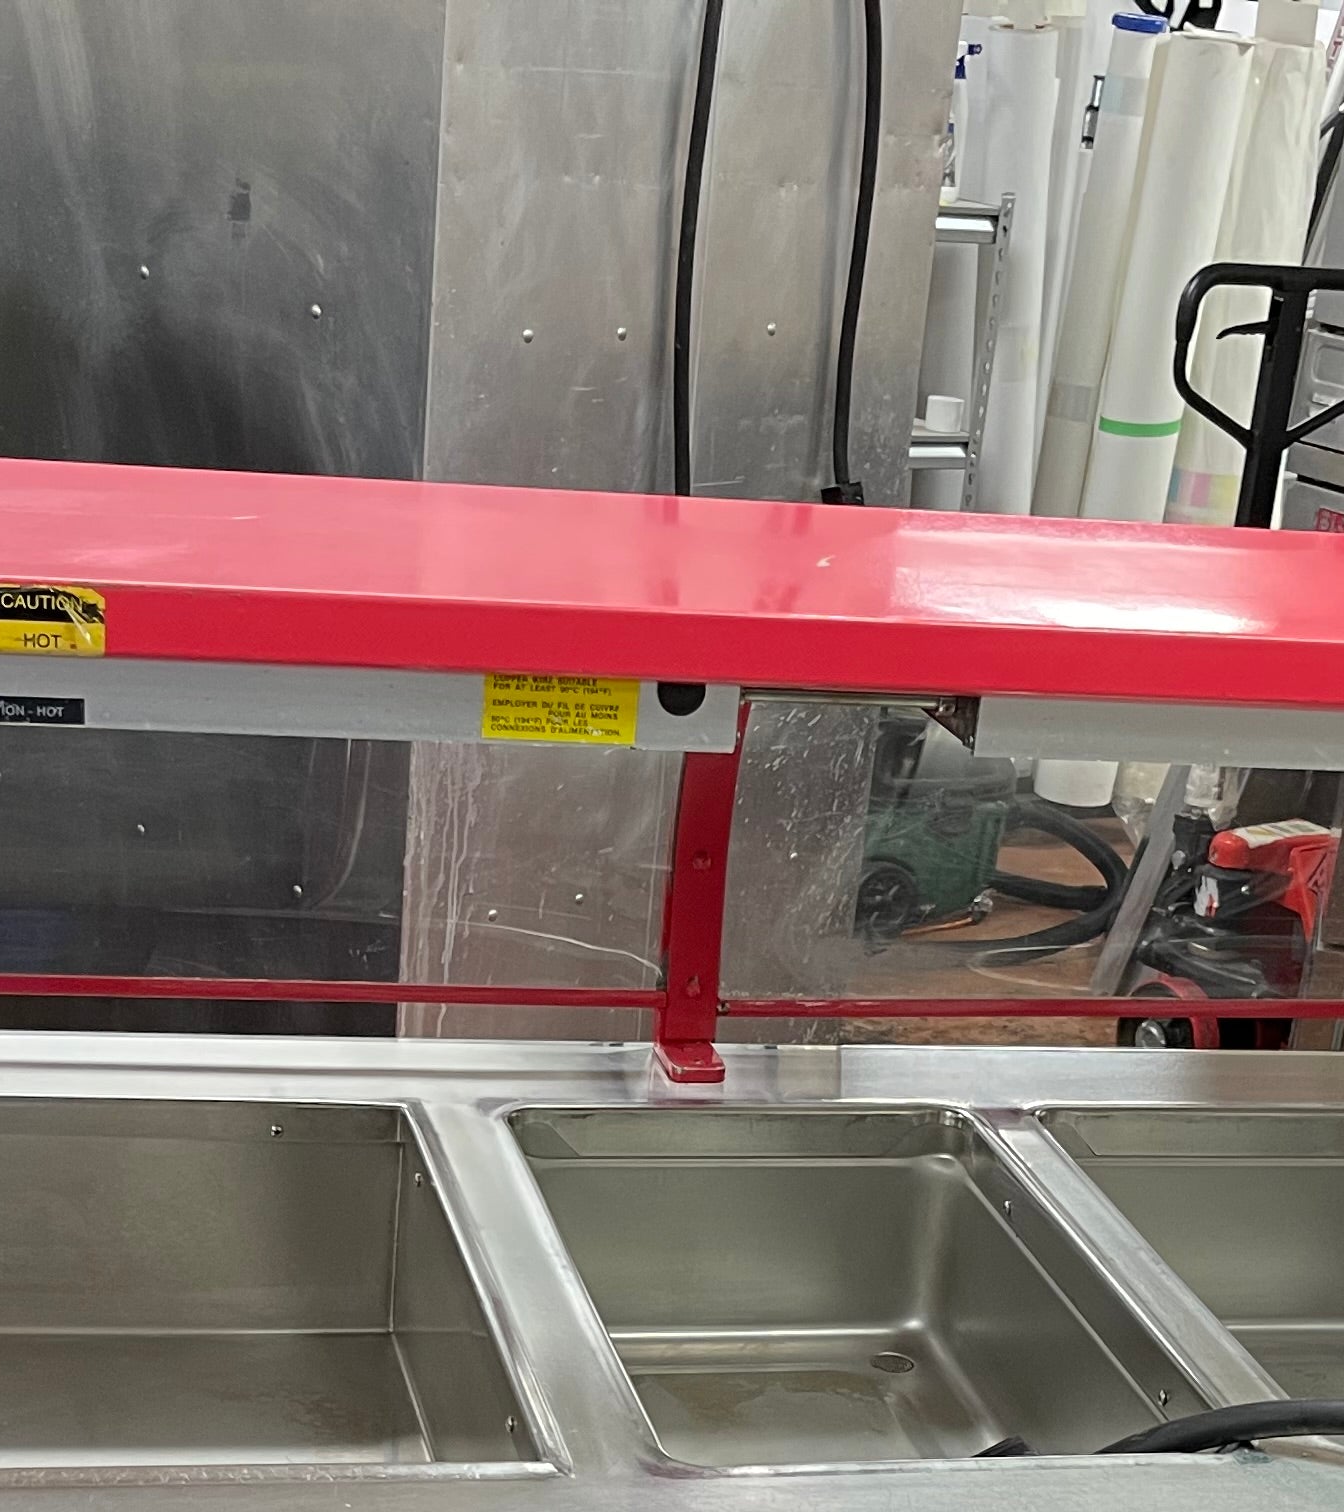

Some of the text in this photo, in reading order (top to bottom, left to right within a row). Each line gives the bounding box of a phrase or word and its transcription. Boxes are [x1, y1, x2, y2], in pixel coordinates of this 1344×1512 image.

[0, 592, 83, 614] CAUTION
[22, 633, 62, 649] HOT
[515, 683, 527, 691] AT
[36, 705, 65, 718] HOT
